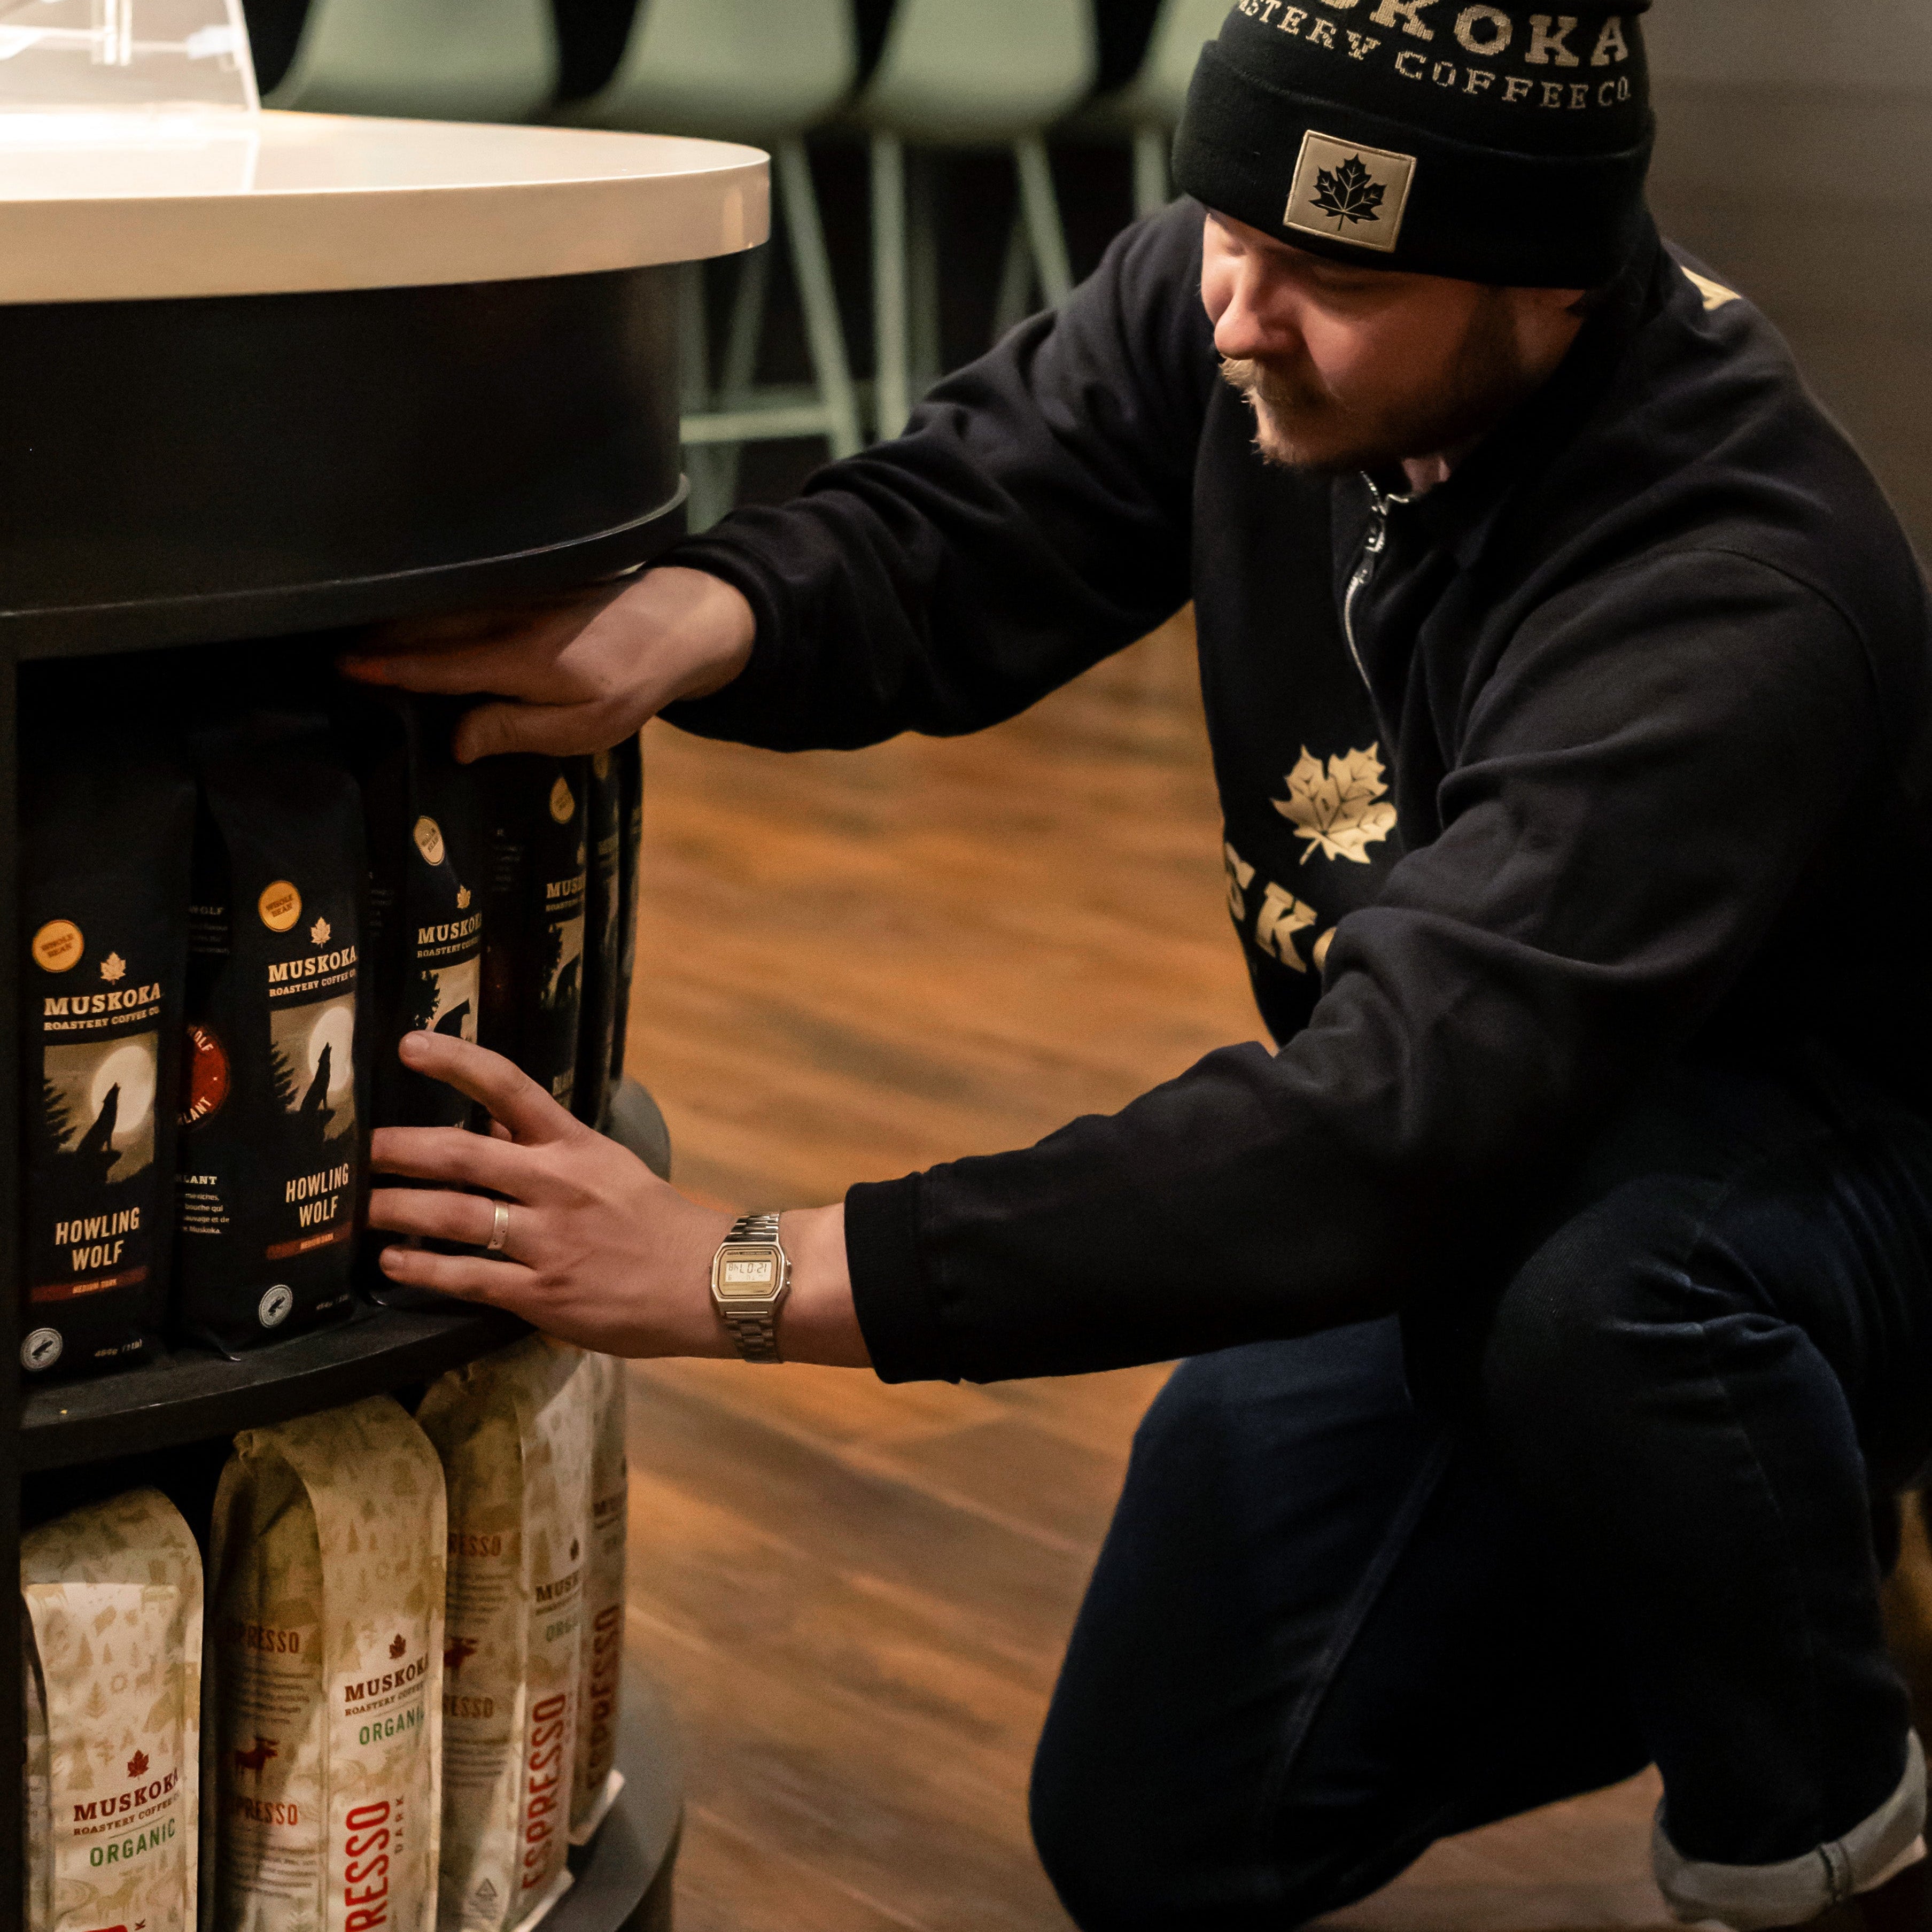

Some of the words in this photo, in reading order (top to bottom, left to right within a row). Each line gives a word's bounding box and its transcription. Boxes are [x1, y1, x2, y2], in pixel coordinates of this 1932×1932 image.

[1319, 0, 1628, 67] KOKA
[1394, 51, 1588, 109] COFFEE
[268, 945, 358, 983] MUSKOKA
[43, 983, 161, 1016] MUSKOKA
[269, 980, 320, 997] ROASTERY
[43, 1018, 110, 1031] ROASTERY
[285, 1162, 350, 1204] HOWLING
[55, 1206, 141, 1246] HOWLING
[299, 1195, 339, 1228] WOLF
[72, 1239, 125, 1272] WOLF
[74, 1815, 135, 1835] ROASTERY
[138, 1798, 172, 1820] COFFEE
[90, 1818, 175, 1867] ORGANIC
